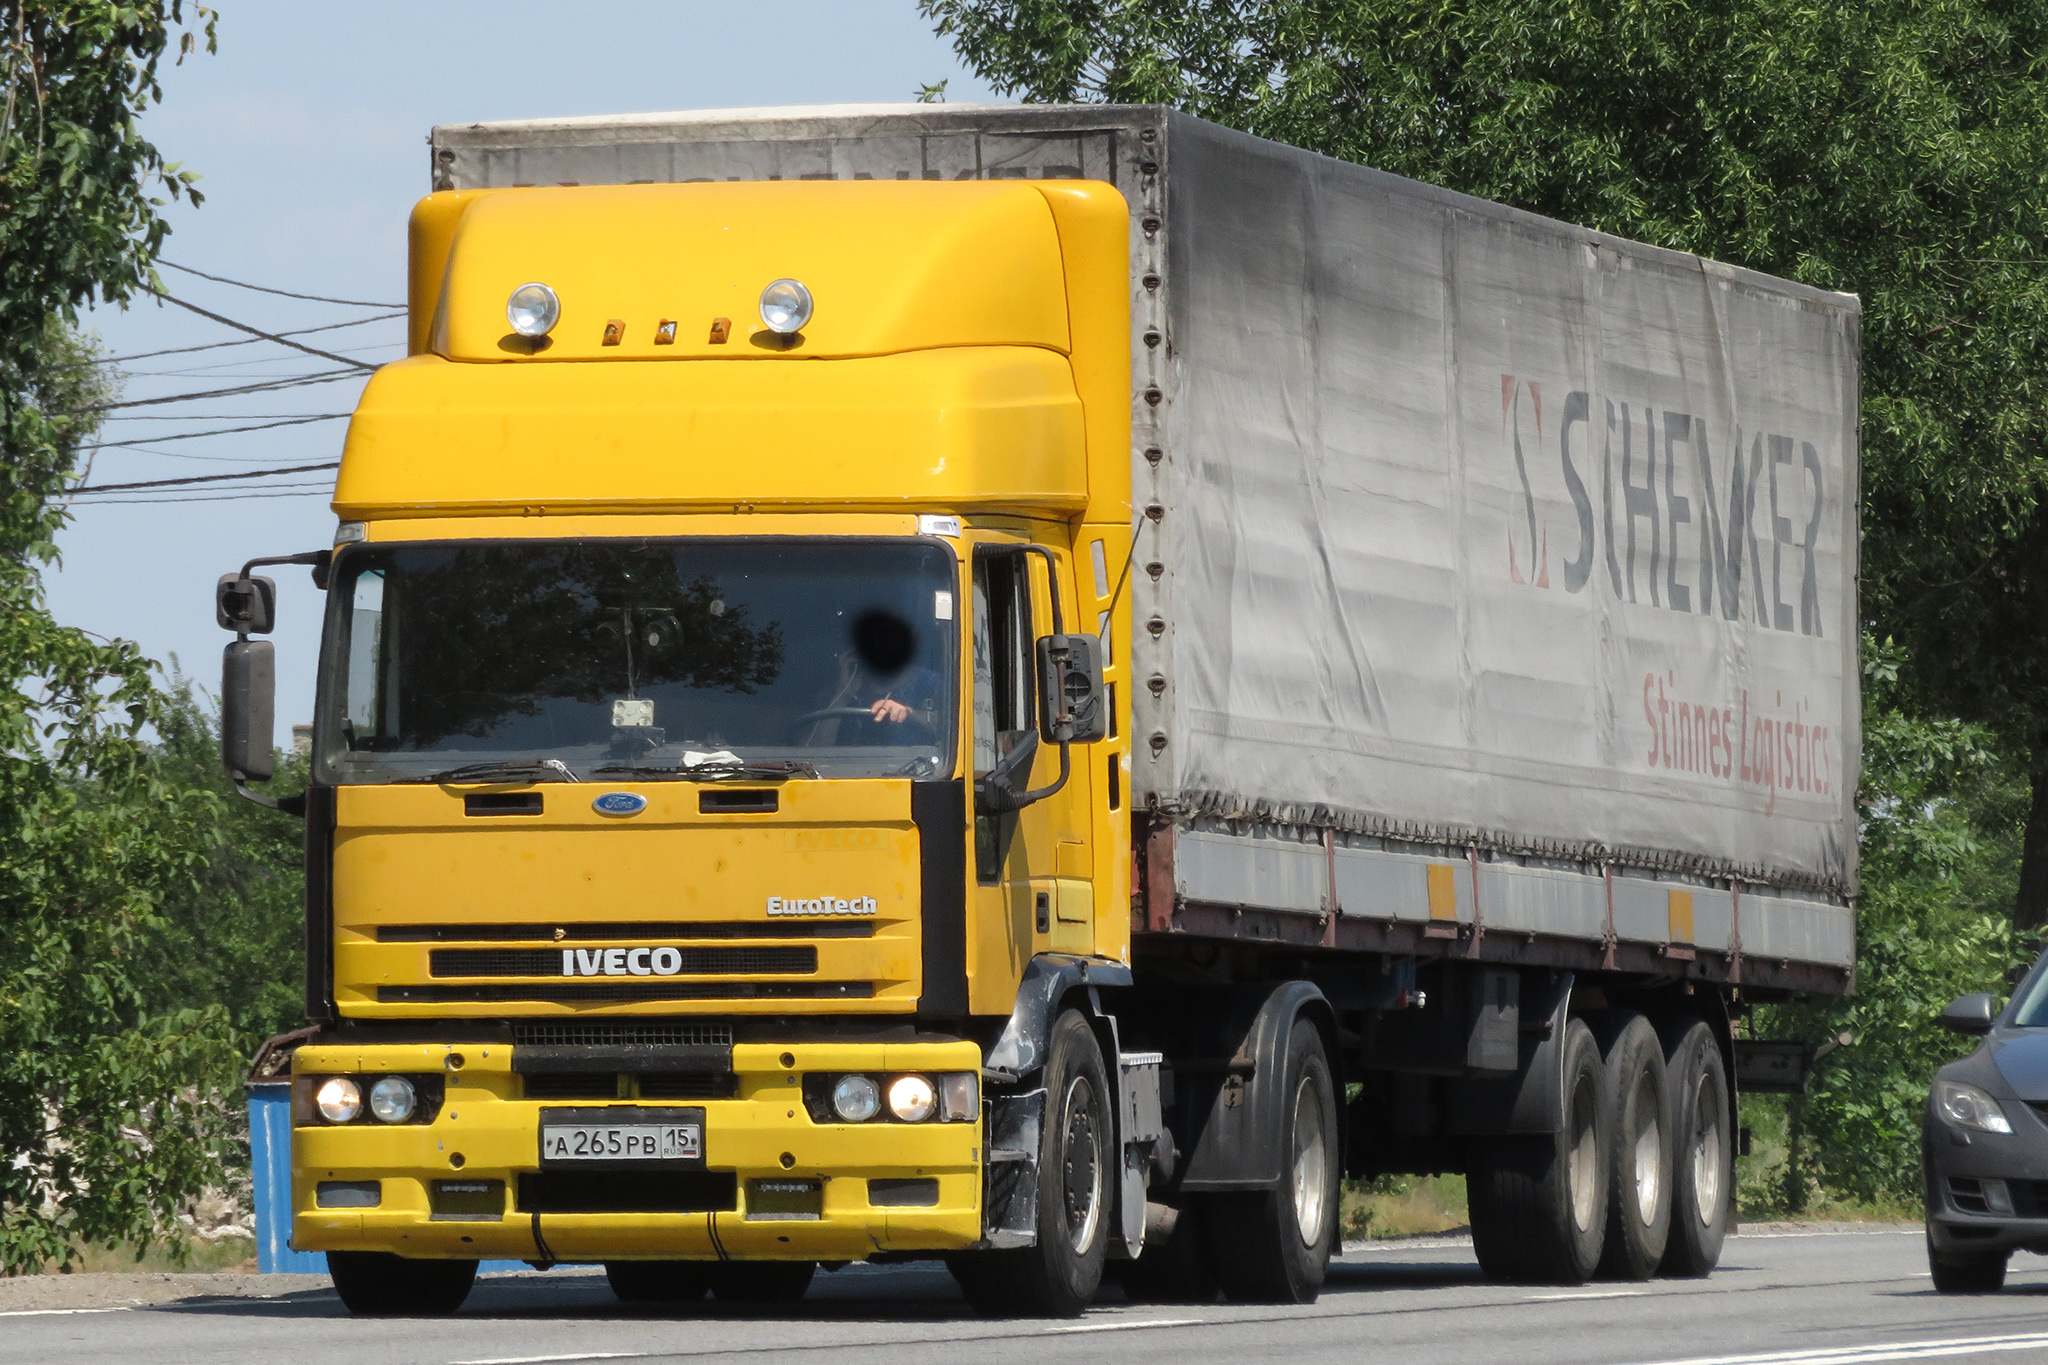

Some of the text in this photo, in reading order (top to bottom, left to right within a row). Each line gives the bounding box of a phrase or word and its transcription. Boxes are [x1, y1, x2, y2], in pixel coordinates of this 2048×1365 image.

[1643, 669, 1830, 817] Stinnes Logistics
[604, 794, 635, 809] Ford
[767, 896, 877, 915] EuroTech
[563, 947, 682, 976] IVECO
[665, 1129, 689, 1147] 15
